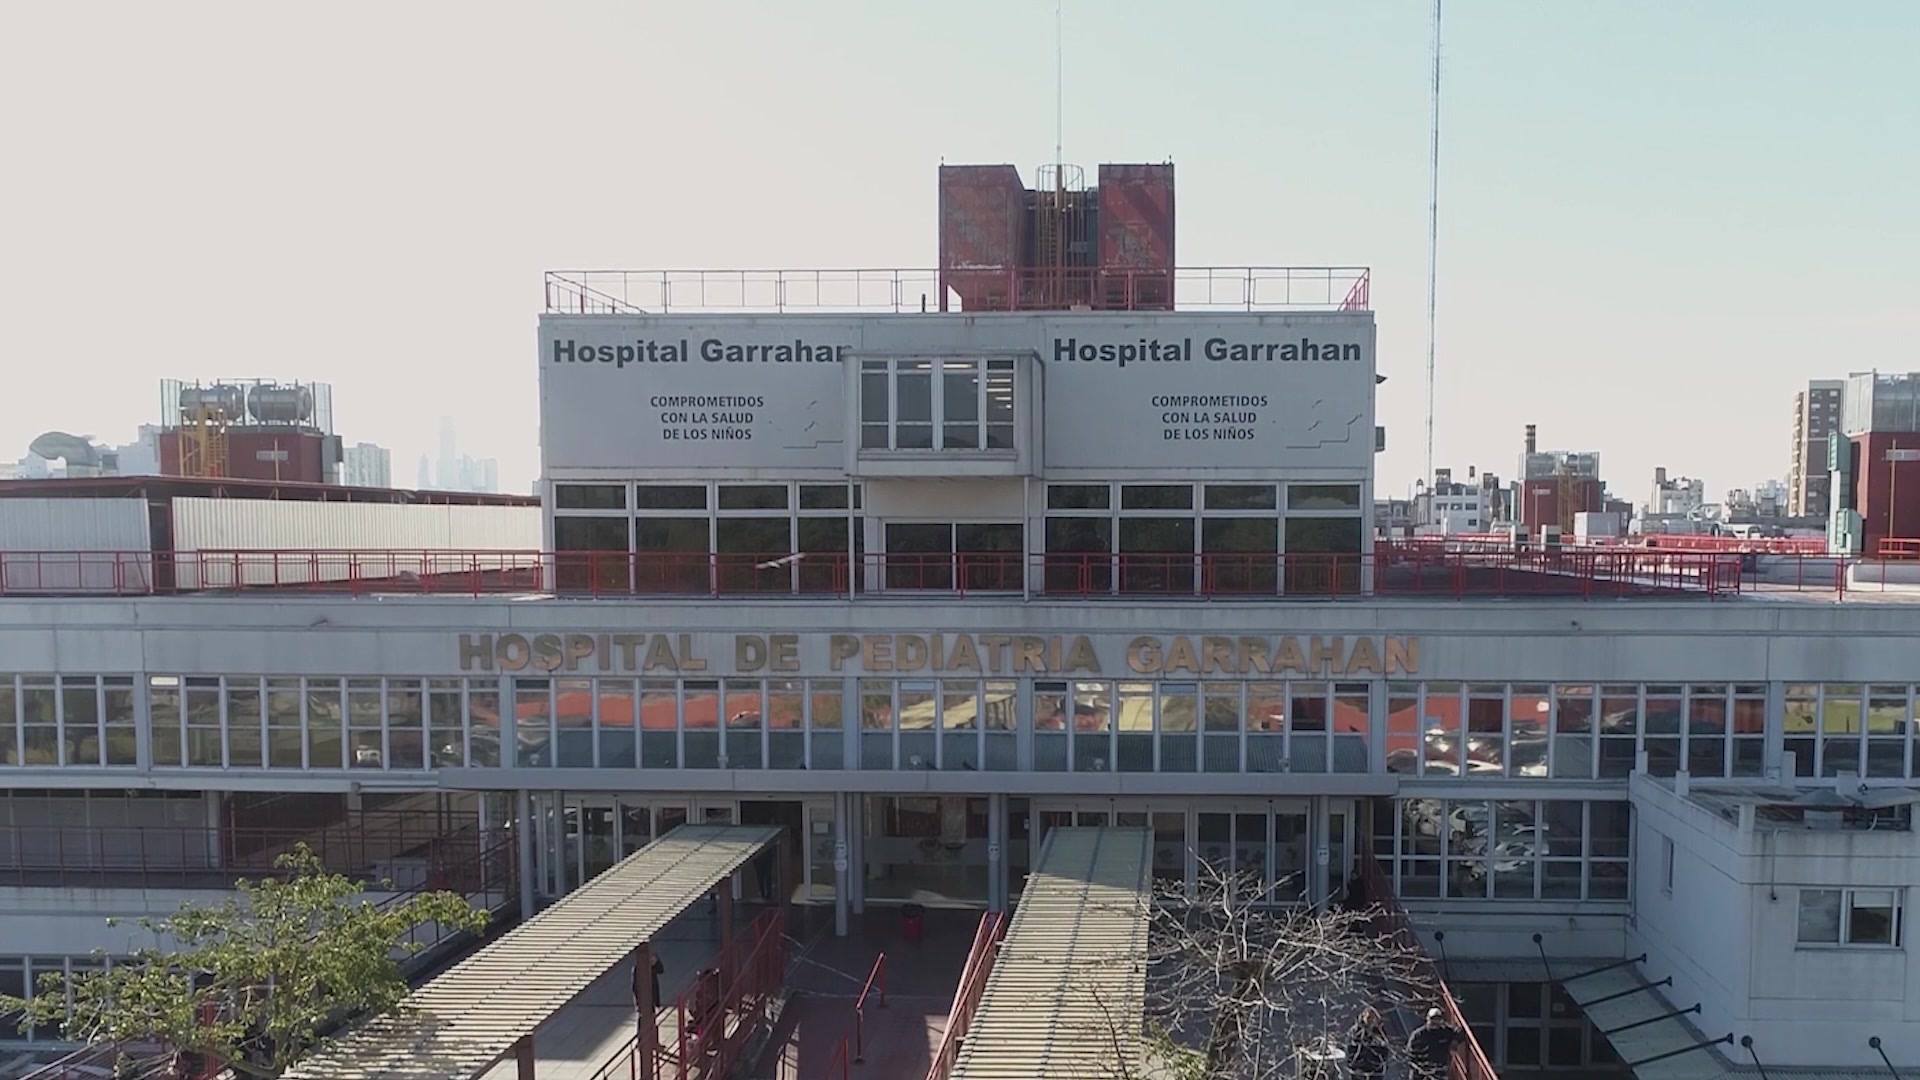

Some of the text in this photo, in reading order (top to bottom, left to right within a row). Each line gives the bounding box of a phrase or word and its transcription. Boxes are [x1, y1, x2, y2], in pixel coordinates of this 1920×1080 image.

[553, 339, 688, 368] Hospital
[1054, 338, 1361, 367] Hospital Garrahan
[650, 396, 764, 408] COMPROMETIDOS
[1151, 395, 1268, 407] COMPROMETIDOS
[661, 412, 754, 424] CON LA SALUD
[1162, 412, 1257, 424] CON LA SALUD
[663, 426, 752, 440] DE LOS NIÑOS
[1163, 426, 1255, 440] DE LOS NIÑOS
[459, 633, 1419, 674] HOSPITAL DE PEDIATRIA GARRAHAN
